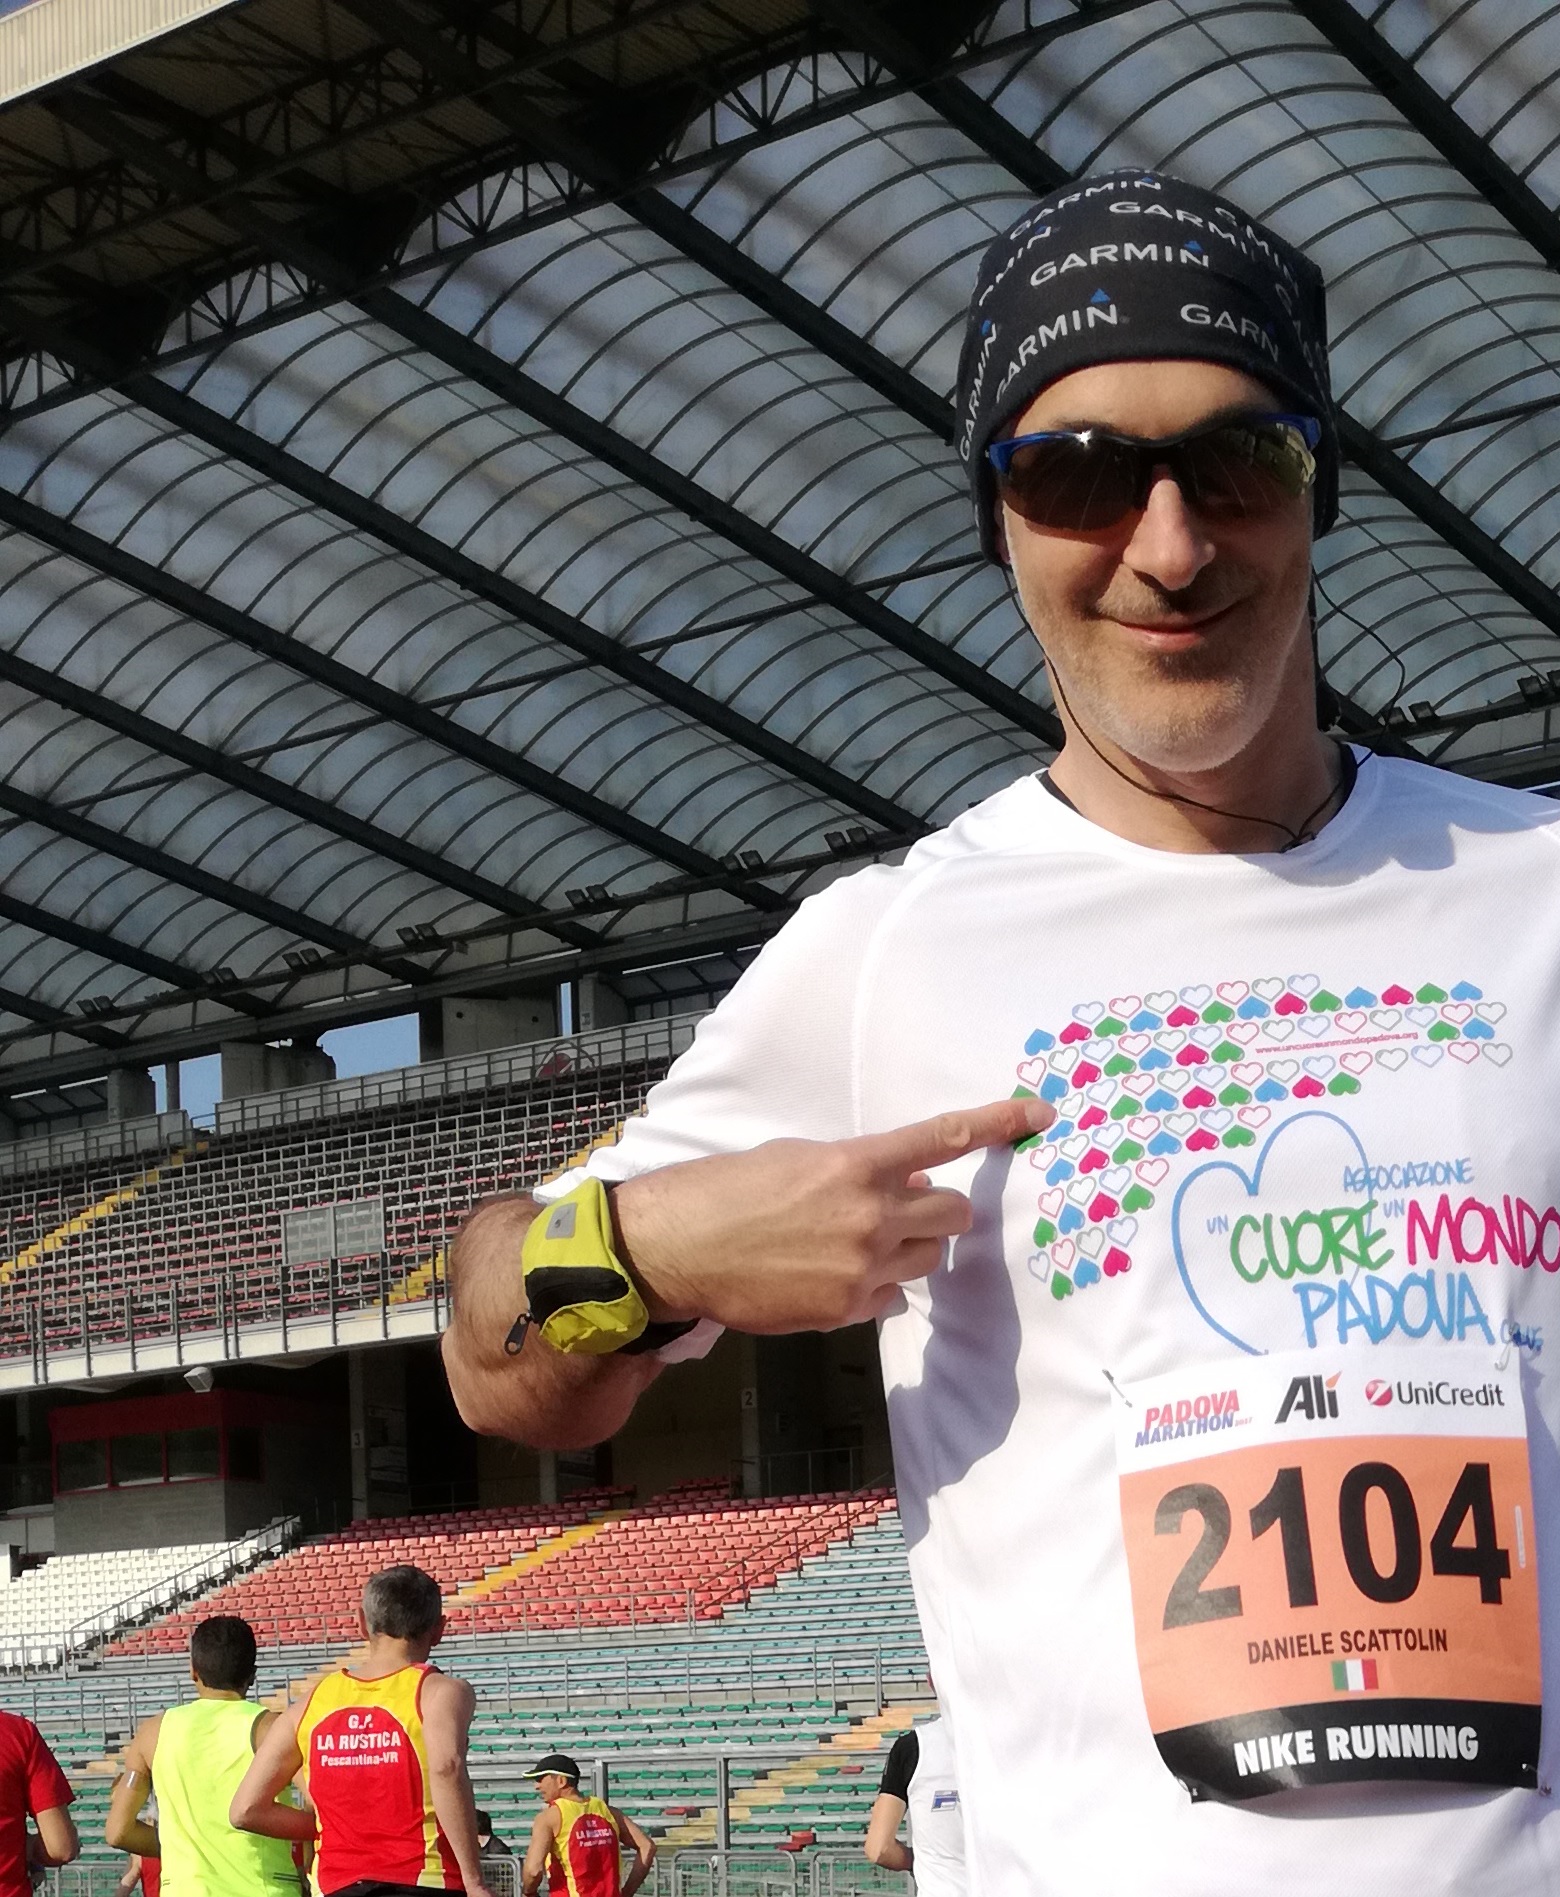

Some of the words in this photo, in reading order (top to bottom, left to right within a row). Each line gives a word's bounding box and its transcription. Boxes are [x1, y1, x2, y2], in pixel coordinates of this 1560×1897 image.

[1009, 180, 1162, 241] GARMIN
[1029, 242, 1210, 288] GARMIN
[1343, 1157, 1475, 1192] ASSOCIAZIONE
[1207, 1215, 1229, 1236] UN
[1230, 1200, 1394, 1283] CUORE
[1383, 1198, 1406, 1219] UN
[1293, 1269, 1495, 1348] PADOVA
[1145, 1389, 1240, 1431] PADOVA
[1396, 1380, 1505, 1408] UniCredit
[1135, 1411, 1235, 1448] MARATHON
[1154, 1461, 1511, 1631] 2104
[1247, 1631, 1335, 1665] DANIELE
[1340, 1627, 1449, 1655] SCATTOLIN
[316, 1734, 335, 1751] LA
[338, 1730, 402, 1751] RUSTICA
[320, 1750, 399, 1767] Pescantina-VR
[1233, 1730, 1317, 1777] NIKE
[1326, 1723, 1479, 1761] RUNNING
